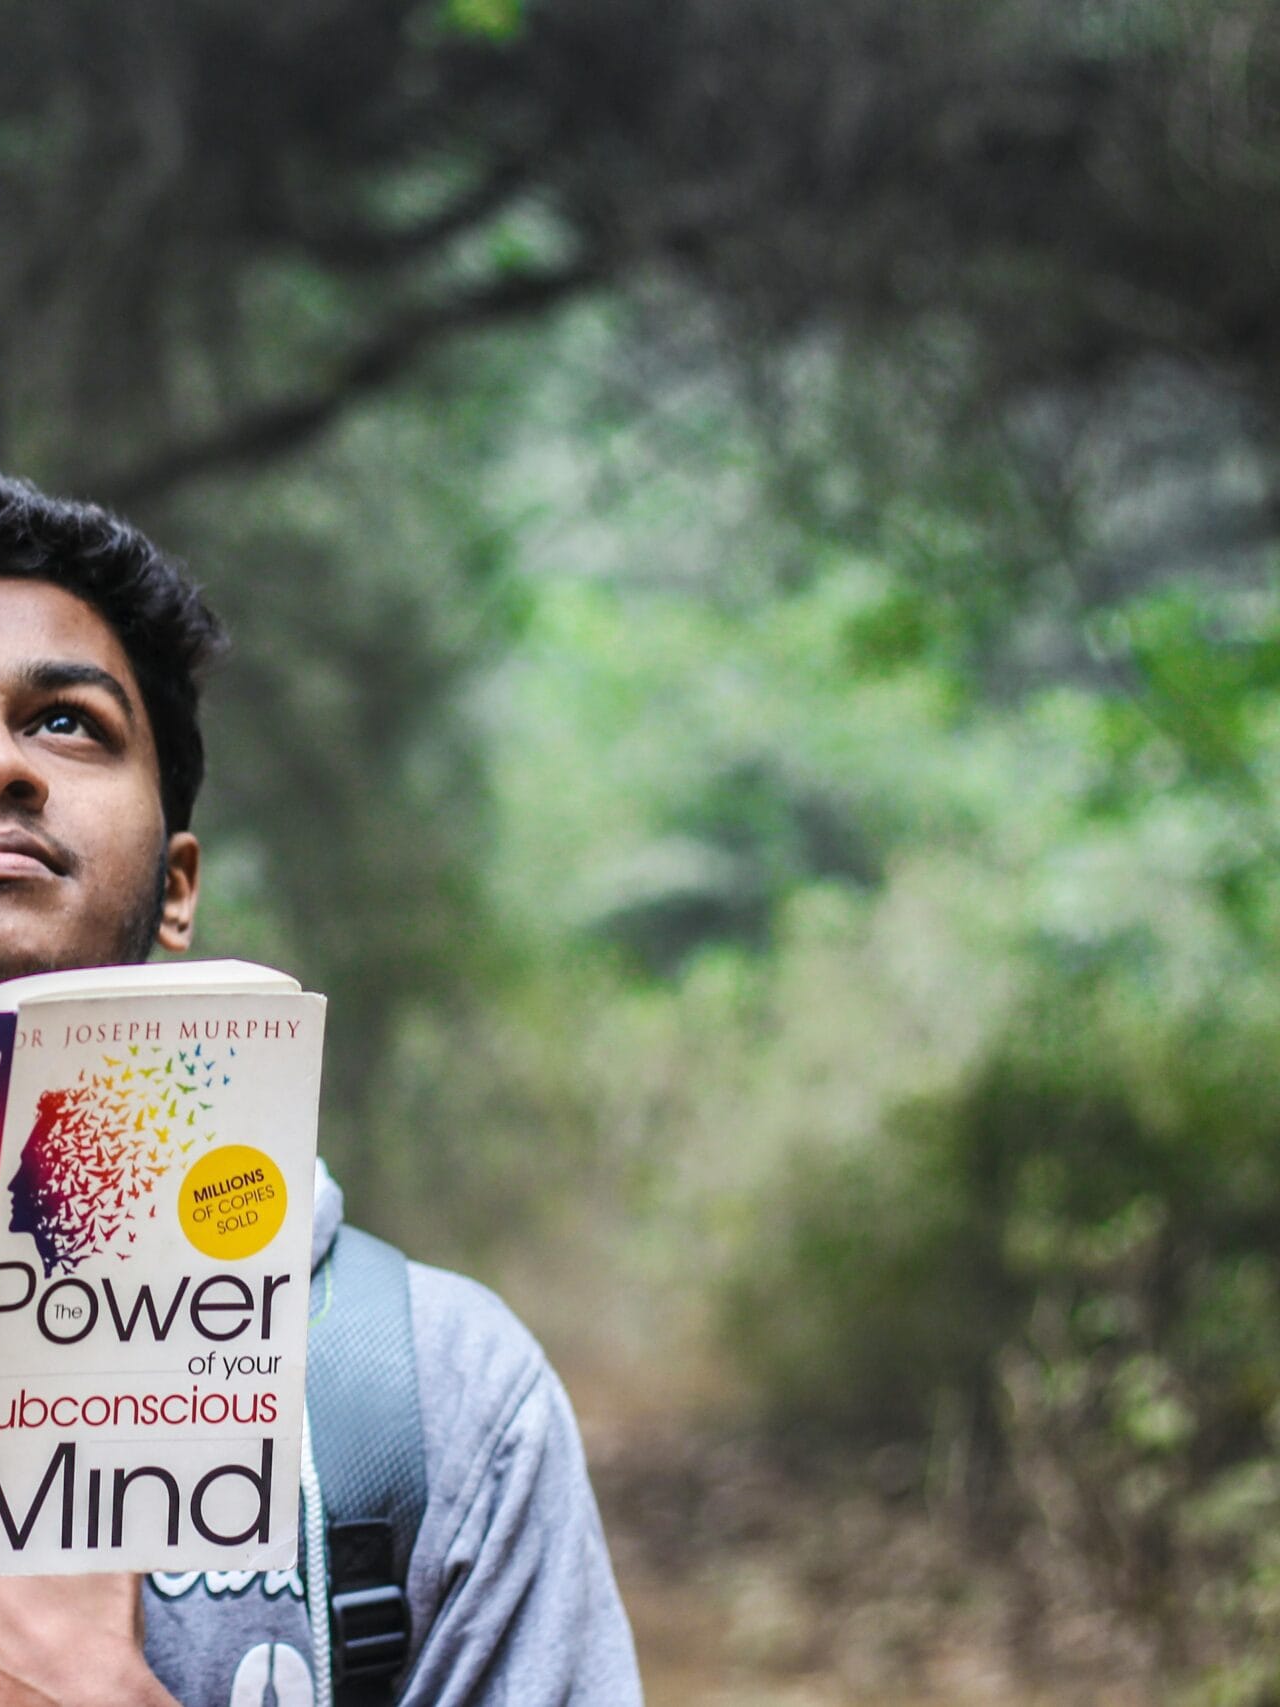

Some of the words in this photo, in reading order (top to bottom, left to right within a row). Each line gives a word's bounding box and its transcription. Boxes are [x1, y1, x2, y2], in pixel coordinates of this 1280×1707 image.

[64, 1021, 161, 1048] JOSEPH
[178, 1019, 301, 1040] MURPHY
[193, 1168, 265, 1203] MILLIONS
[192, 1204, 214, 1223] OF
[218, 1184, 275, 1214] COPIES
[216, 1210, 259, 1235] SOLD
[53, 1303, 83, 1321] The
[187, 1350, 217, 1375] of
[223, 1354, 282, 1380] your
